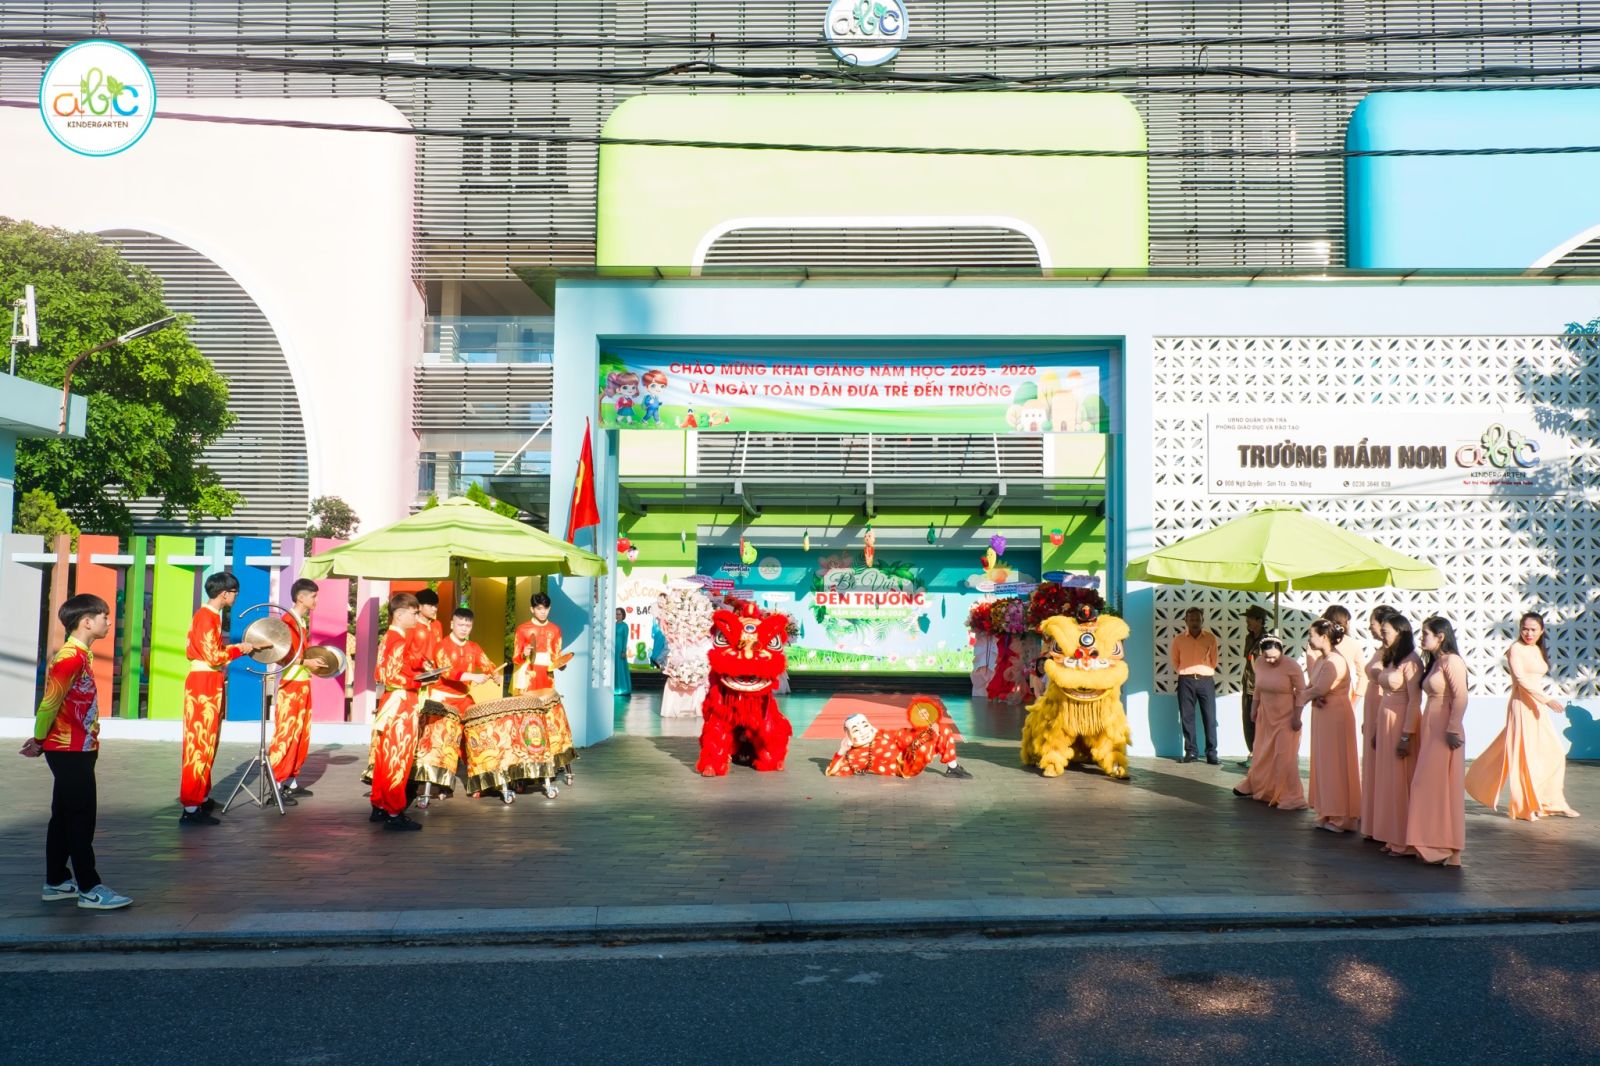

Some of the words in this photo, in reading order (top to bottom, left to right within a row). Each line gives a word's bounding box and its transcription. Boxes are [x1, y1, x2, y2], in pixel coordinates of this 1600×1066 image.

[669, 360, 716, 375] CHÀO
[720, 361, 767, 376] MỪNG
[772, 364, 808, 376] KHAI
[870, 362, 905, 377] NĂM
[910, 365, 945, 380] HỌC
[951, 365, 987, 376] 2025
[1000, 364, 1037, 376] 2026
[689, 380, 710, 394] VÀ
[715, 381, 758, 395] NGÀY
[763, 380, 804, 396] TOÀN
[810, 382, 842, 397] DÂN
[847, 384, 879, 397] ĐƯA
[884, 381, 909, 397] TRẺ
[913, 380, 943, 397] ĐẾN
[949, 383, 1012, 397] TRƯỜNG
[1237, 439, 1327, 469] TRƯỜNG
[1398, 445, 1446, 469] NON
[1470, 471, 1526, 479] KINDERGARTEN
[861, 570, 895, 591] Vui
[815, 584, 850, 605] ĐẾN
[854, 587, 924, 605] TRƯỜNG
